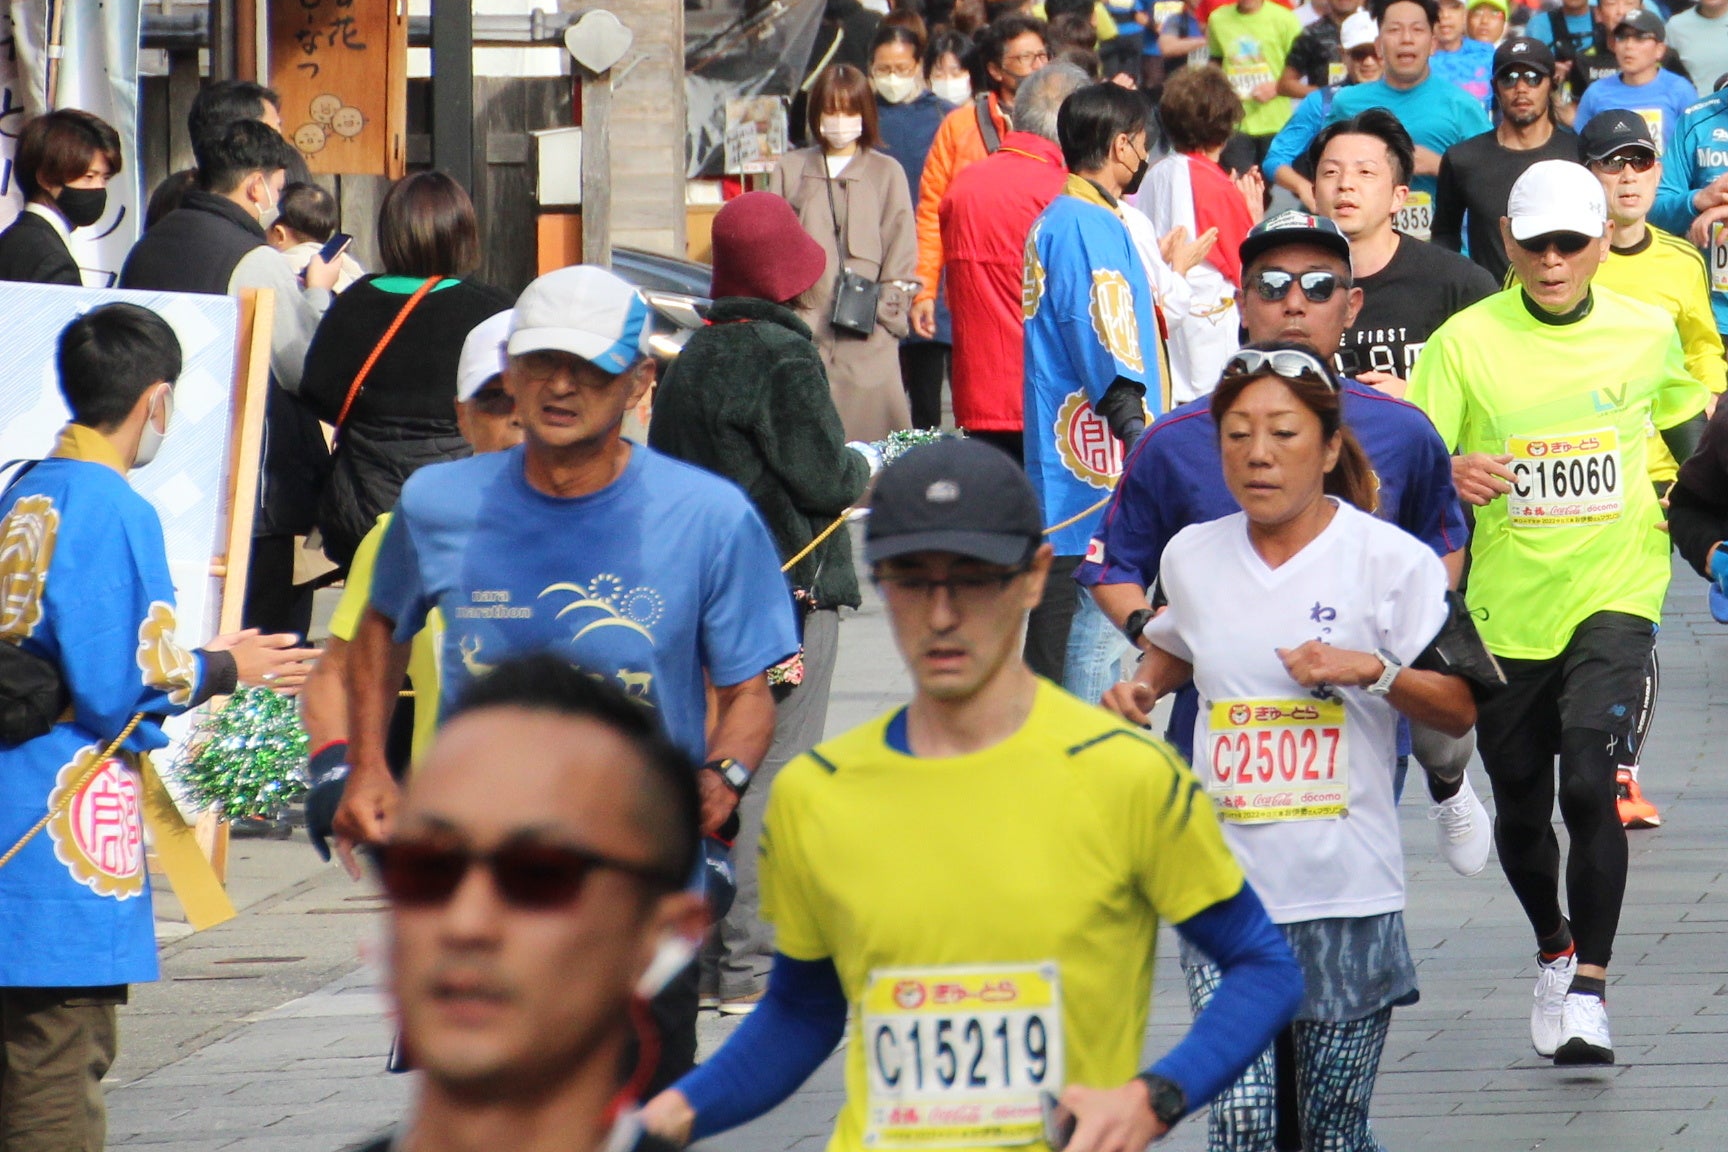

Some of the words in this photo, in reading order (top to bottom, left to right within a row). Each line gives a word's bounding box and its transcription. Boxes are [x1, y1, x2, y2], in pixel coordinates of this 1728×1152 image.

[1357, 328, 1407, 345] FIRST
[1513, 454, 1616, 498] C16060
[1587, 502, 1618, 513] docomo
[456, 605, 532, 618] marathon
[1213, 728, 1341, 784] C25027
[1300, 791, 1342, 803] docomo
[875, 1014, 1048, 1090] C15219
